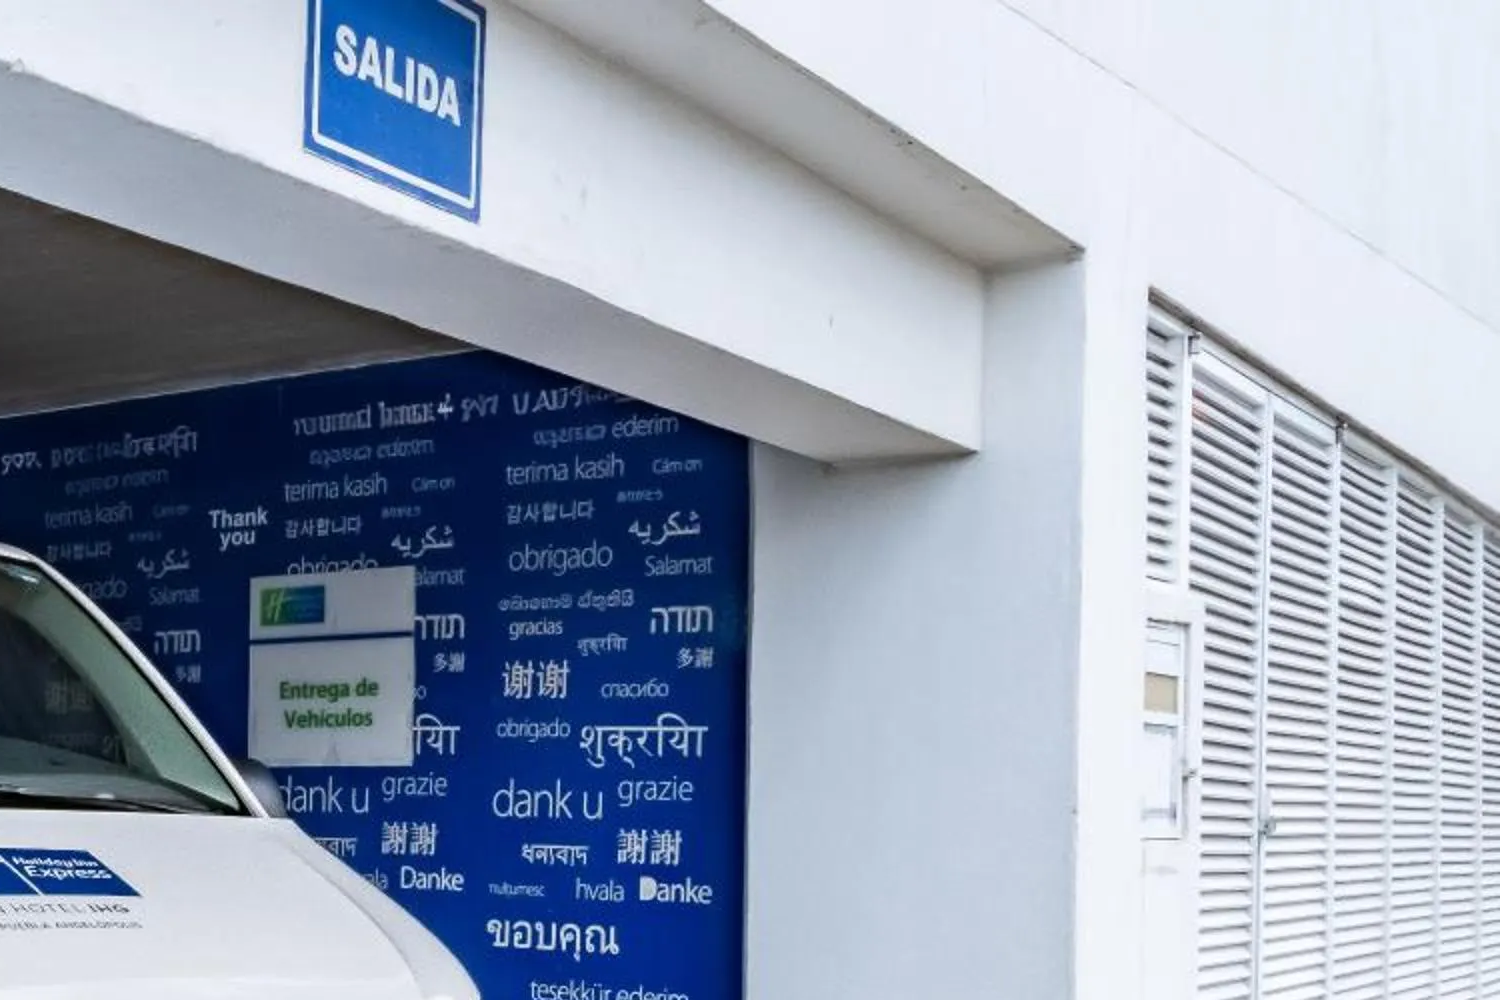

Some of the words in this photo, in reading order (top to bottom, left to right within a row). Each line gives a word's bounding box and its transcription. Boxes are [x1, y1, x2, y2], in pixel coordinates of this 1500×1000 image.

[333, 24, 461, 127] SALIDA
[506, 463, 568, 486] terima
[575, 452, 624, 480] kasih
[285, 480, 339, 502] terima
[344, 471, 387, 498] kasih
[208, 505, 268, 529] Thank
[507, 500, 595, 525] 감사합니다
[219, 529, 256, 552] you
[285, 515, 362, 539] 감사합니다
[509, 539, 614, 576] obrigado
[645, 555, 714, 577] Salamat
[416, 565, 467, 587] alamat
[509, 617, 563, 640] gracias
[650, 606, 713, 634] תודה
[279, 681, 350, 703] Entrega
[356, 677, 379, 697] de
[502, 660, 570, 699] 谢谢
[497, 717, 571, 742] obrigado
[381, 771, 448, 802] grazie
[492, 778, 573, 819] dank
[583, 791, 603, 820] u
[618, 775, 695, 807] grazie
[351, 787, 369, 814] u
[381, 821, 439, 856] 謝謝
[617, 829, 682, 866] 謝謝
[24, 865, 112, 880] Express
[400, 865, 464, 891] Danke
[576, 877, 624, 903] hvala
[639, 876, 713, 905] Danke
[486, 917, 620, 962] ขอบคุณ
